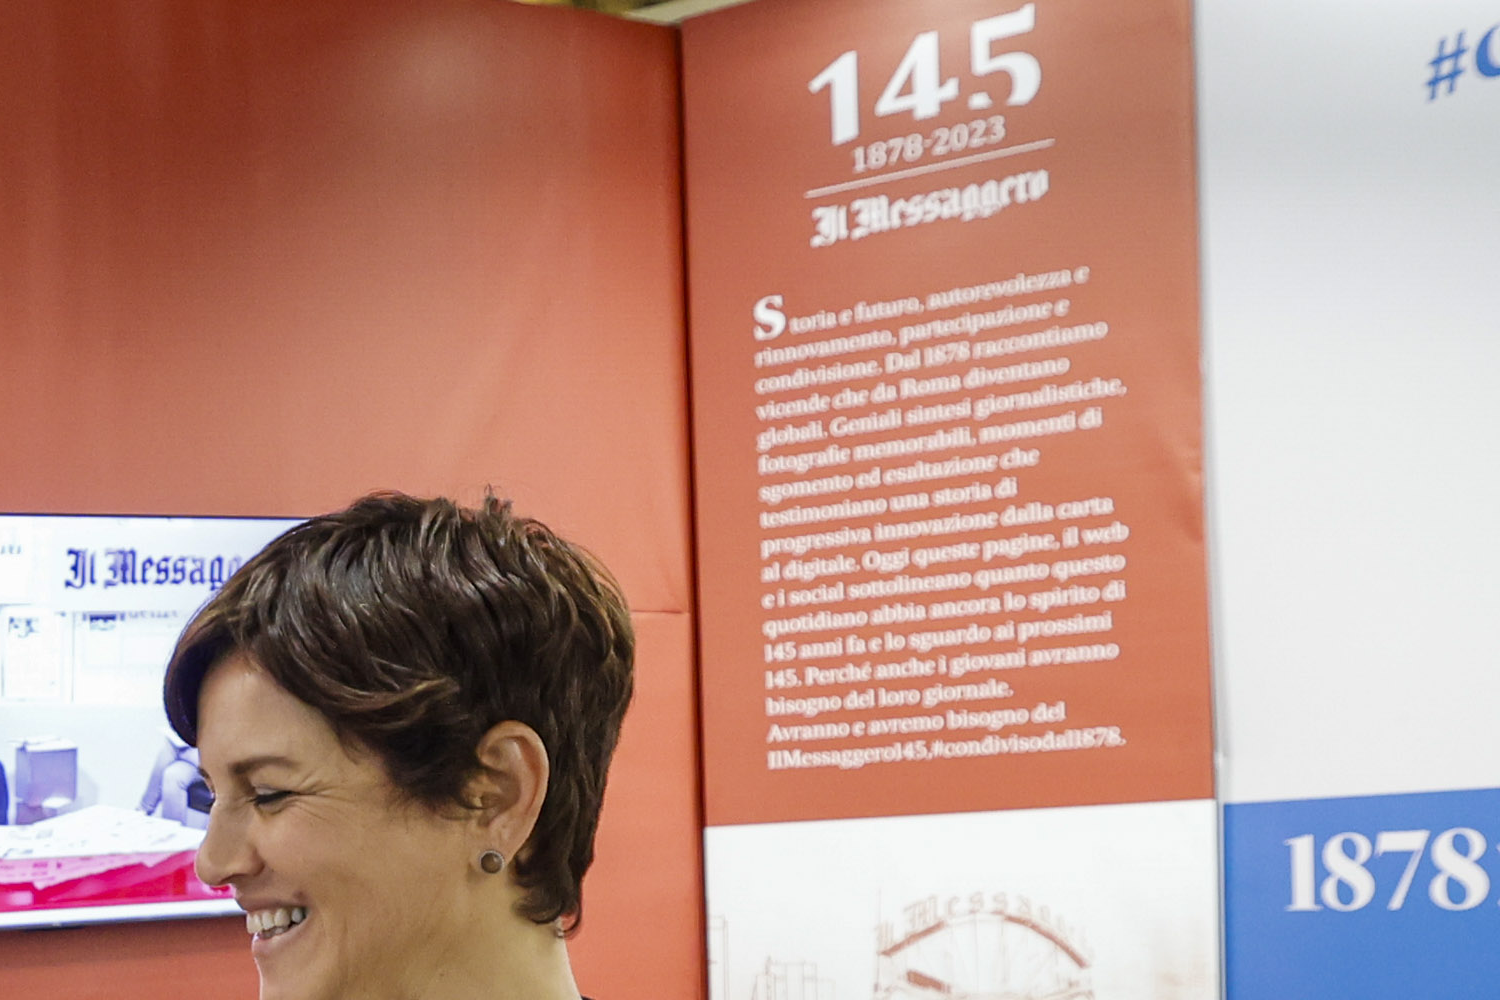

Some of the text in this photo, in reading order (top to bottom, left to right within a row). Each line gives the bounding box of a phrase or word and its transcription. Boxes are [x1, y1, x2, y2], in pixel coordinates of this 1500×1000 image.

[808, 4, 1042, 146] 145
[852, 115, 1006, 173] 1878-2023
[809, 169, 1049, 248] Il Messaggero
[838, 309, 852, 325] e
[926, 270, 1072, 310] autorevolezza
[1074, 267, 1089, 283] e
[899, 302, 1053, 347] partecipazione
[1054, 300, 1069, 316] e
[885, 349, 921, 373] Dal
[924, 341, 970, 367] 1878
[973, 322, 1108, 359] raccontiamo
[756, 358, 1070, 420] vicende che da Roma diventano
[758, 444, 851, 474] fotografie
[979, 411, 1076, 444] momenti
[1078, 407, 1102, 429] di
[829, 408, 902, 436] Geniali
[905, 398, 971, 426] sintesi
[759, 447, 1040, 504] sgomento ed esaltazione che
[760, 477, 1017, 528] testimoniano una storia di
[761, 498, 1114, 559] progressiva innovazione dalla carta
[761, 562, 780, 582] al
[862, 547, 910, 573] Oggi
[912, 543, 980, 568] queste
[1063, 527, 1079, 548] il
[1081, 522, 1129, 544] web
[64, 549, 97, 589] Il
[762, 555, 1126, 609] e i social sottolineano quanto questo
[763, 580, 1126, 640] quotidiano abbia ancora lo spirito di
[765, 611, 1112, 662] 145 anni fa e lo sguardo ai prossimi
[805, 662, 872, 686] Perché
[874, 657, 936, 679] anche
[938, 655, 947, 674] i
[949, 648, 1026, 677] giovani
[1028, 644, 1119, 666] avranno
[766, 696, 842, 717] bisogno
[843, 689, 875, 710] del
[878, 688, 920, 707] loro
[767, 701, 1066, 742] Avranno e avremo bisogno del
